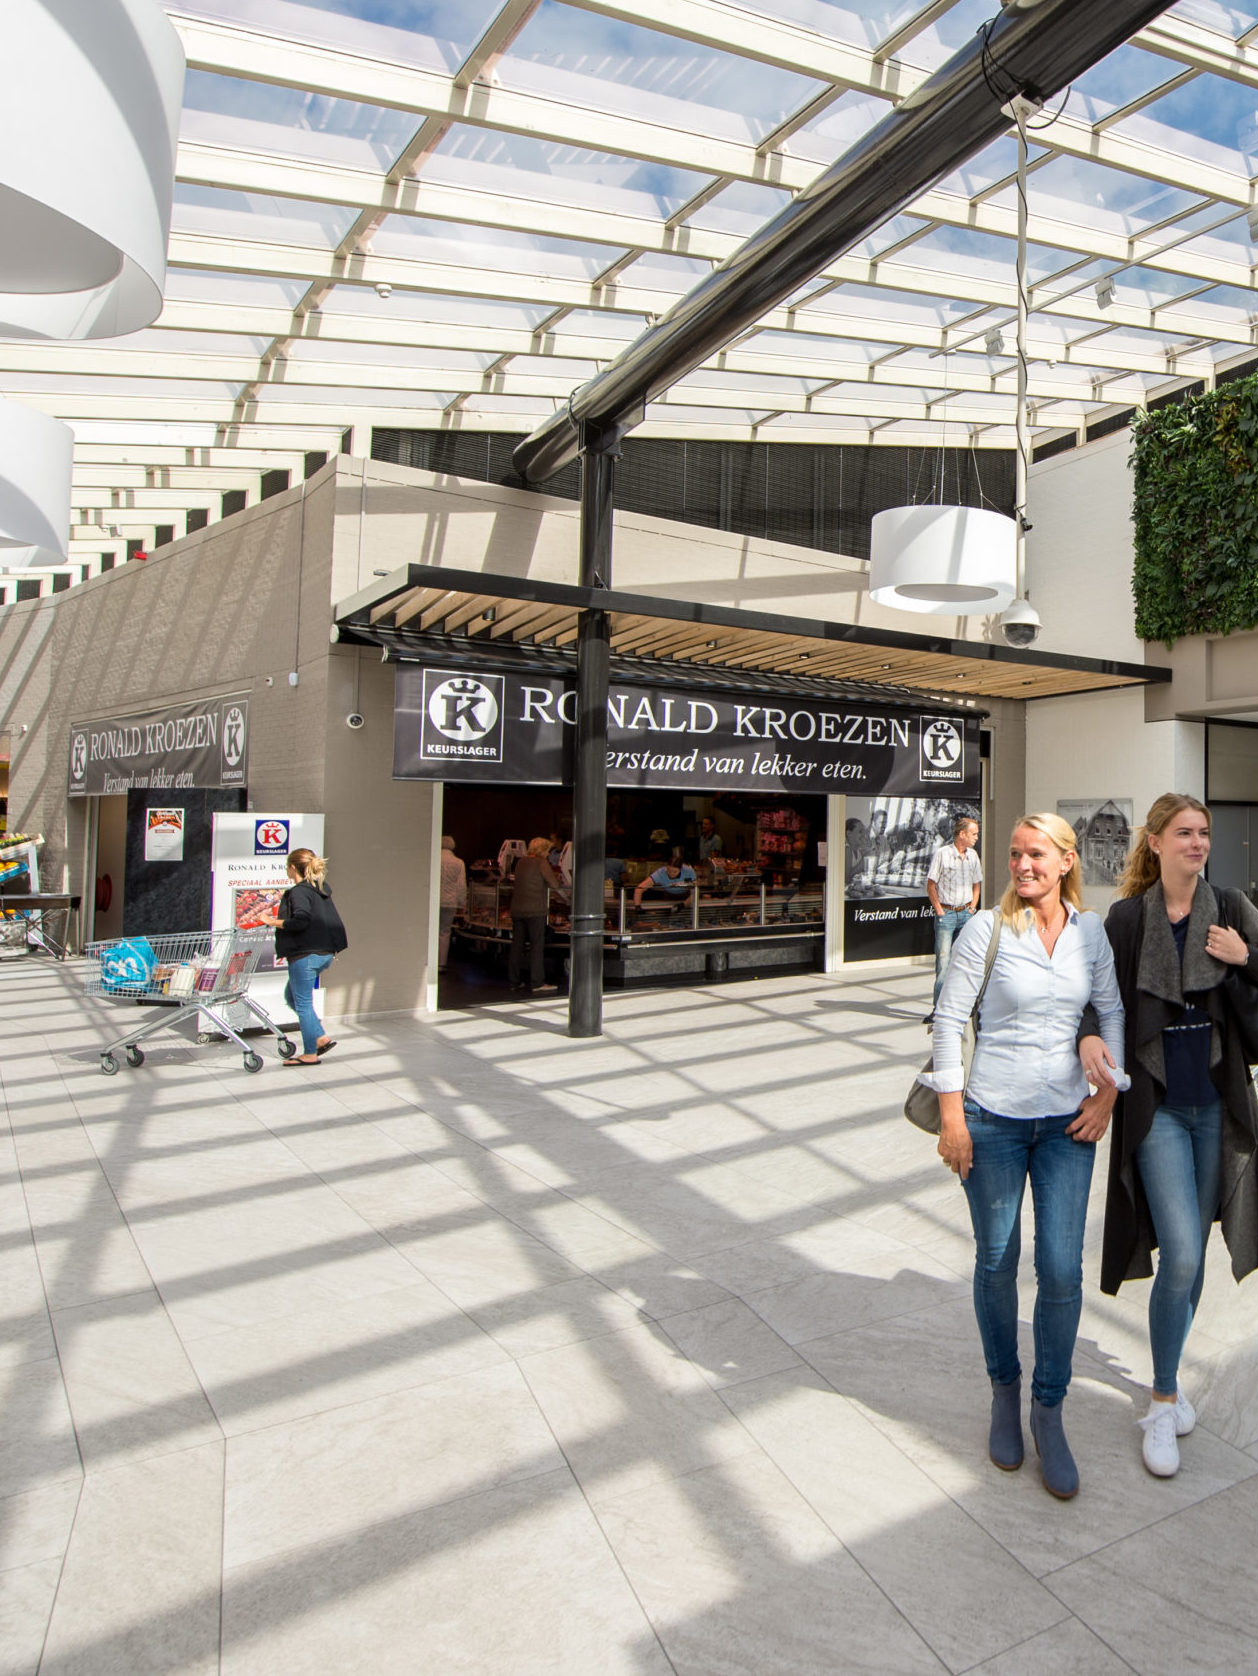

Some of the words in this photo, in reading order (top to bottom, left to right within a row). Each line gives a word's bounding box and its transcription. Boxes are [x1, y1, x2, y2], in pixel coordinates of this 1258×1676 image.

[440, 694, 486, 732] K
[519, 686, 719, 734] RONALD
[733, 704, 911, 748] KROEZEN
[89, 727, 142, 761] RONALD
[145, 712, 219, 755] KROEZEN
[227, 722, 241, 758] K
[930, 734, 954, 761] K
[427, 744, 497, 756] KEURSLAGER
[606, 749, 699, 772] erstand
[703, 756, 745, 774] van
[751, 752, 817, 777] lekker
[822, 760, 867, 779] eten.
[923, 770, 962, 778] KEURSLAGER
[103, 770, 135, 793] Verstand
[135, 776, 149, 788] van
[150, 767, 174, 788] lekker
[175, 772, 195, 788] eten.
[262, 828, 282, 844] K
[266, 878, 295, 886] AANBEV
[854, 906, 899, 921] Verstand
[900, 909, 918, 919] van
[920, 905, 936, 917] lek
